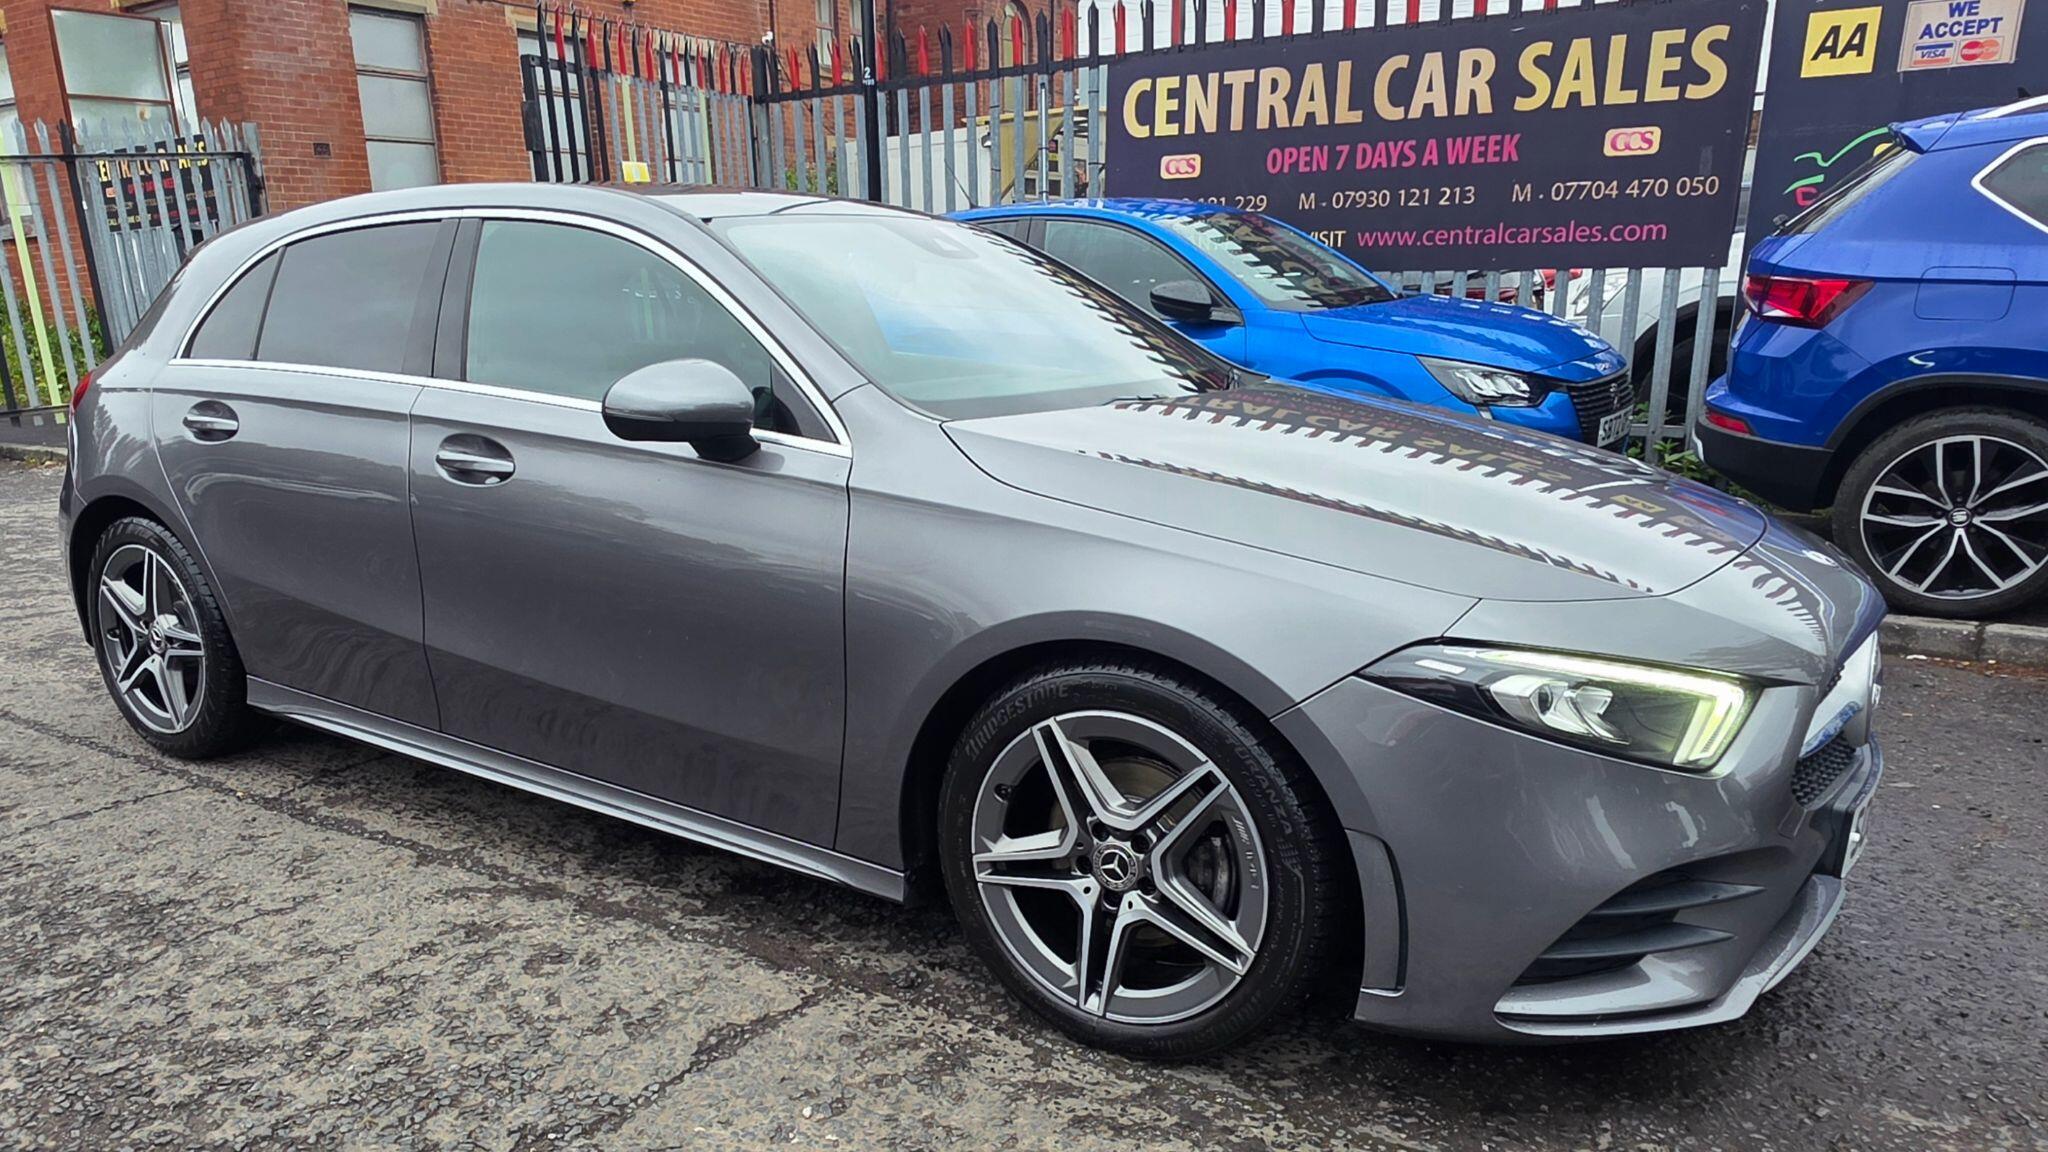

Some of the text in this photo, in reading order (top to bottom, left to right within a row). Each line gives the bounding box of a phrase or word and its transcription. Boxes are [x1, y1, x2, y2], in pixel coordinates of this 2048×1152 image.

[1949, 1, 1981, 18] WE
[1919, 17, 2003, 40] ACCEPT
[1810, 22, 1869, 62] AA
[1920, 49, 1946, 59] VISA
[1123, 24, 1731, 138] CENTRAL CAR SALES
[1610, 130, 1654, 152] CCS
[1266, 133, 1521, 174] OPEN 7 DAYS A WEEK
[1165, 157, 1196, 176] CCS
[1332, 188, 1390, 209] 07930
[1399, 187, 1430, 207] 121
[1438, 186, 1475, 206] 213
[1551, 180, 1618, 201] 07704
[1625, 177, 1669, 198] 470
[1675, 175, 1720, 196] 050
[1235, 195, 1268, 212] 229
[1310, 220, 1668, 248] ISIT www.centralcarsales.com
